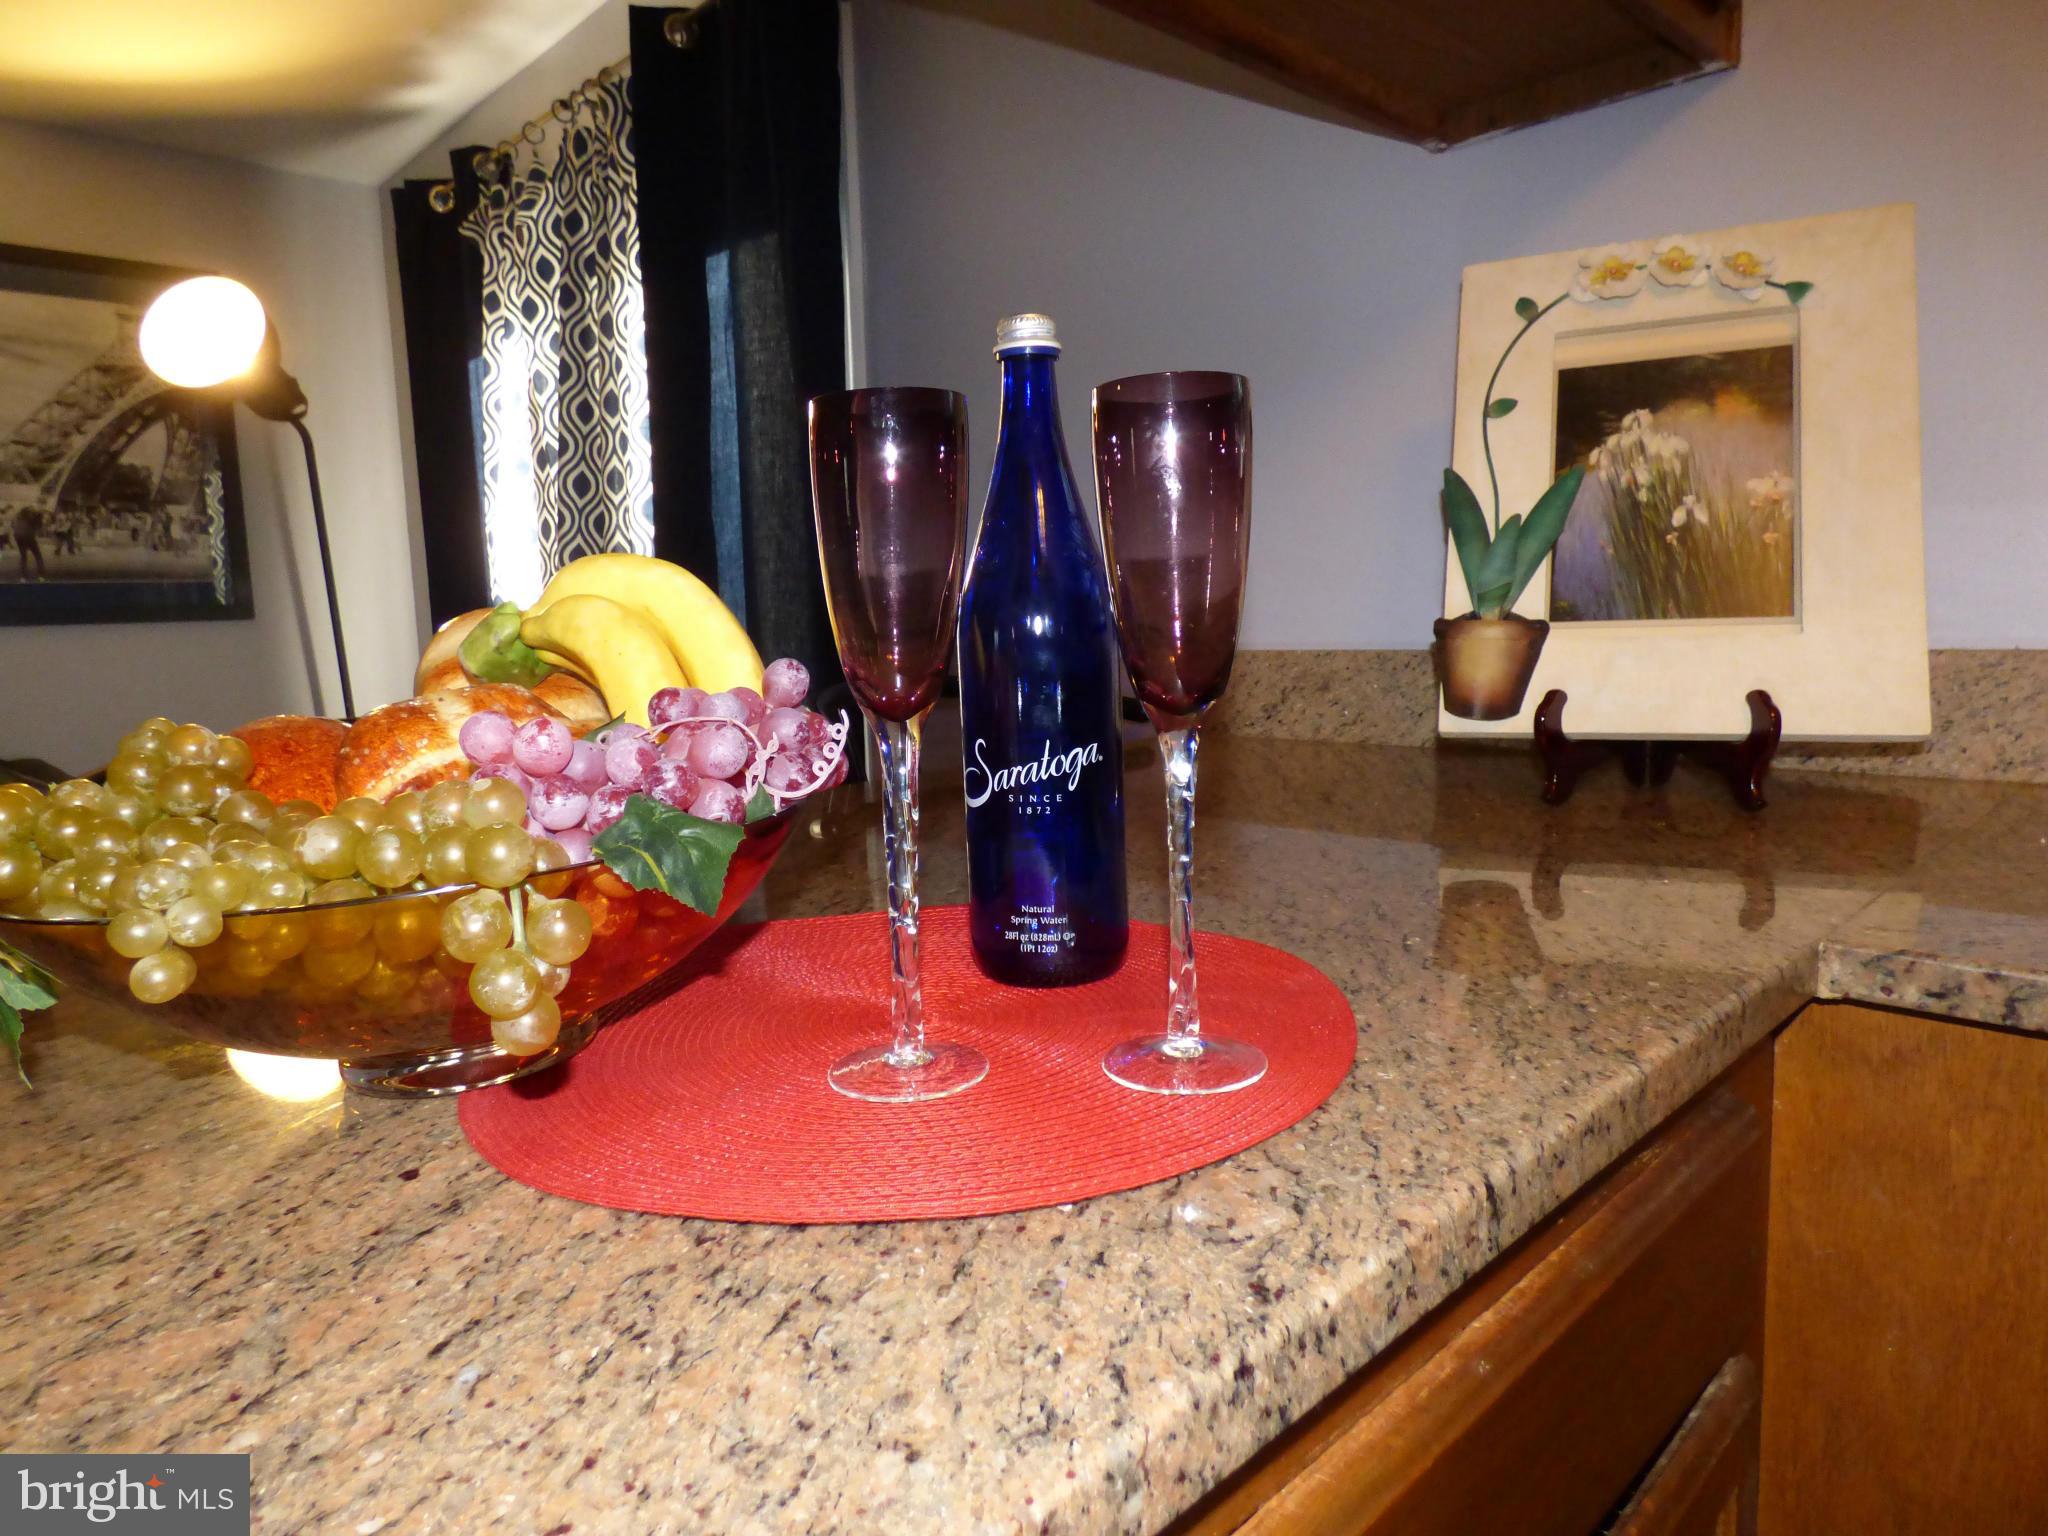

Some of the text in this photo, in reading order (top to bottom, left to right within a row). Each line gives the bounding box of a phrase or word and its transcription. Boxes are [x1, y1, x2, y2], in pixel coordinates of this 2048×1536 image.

[1008, 794, 1063, 803] SINCE
[1018, 806, 1051, 815] 1872
[1021, 905, 1055, 913] Natural
[1010, 915, 1068, 926] Spring Water
